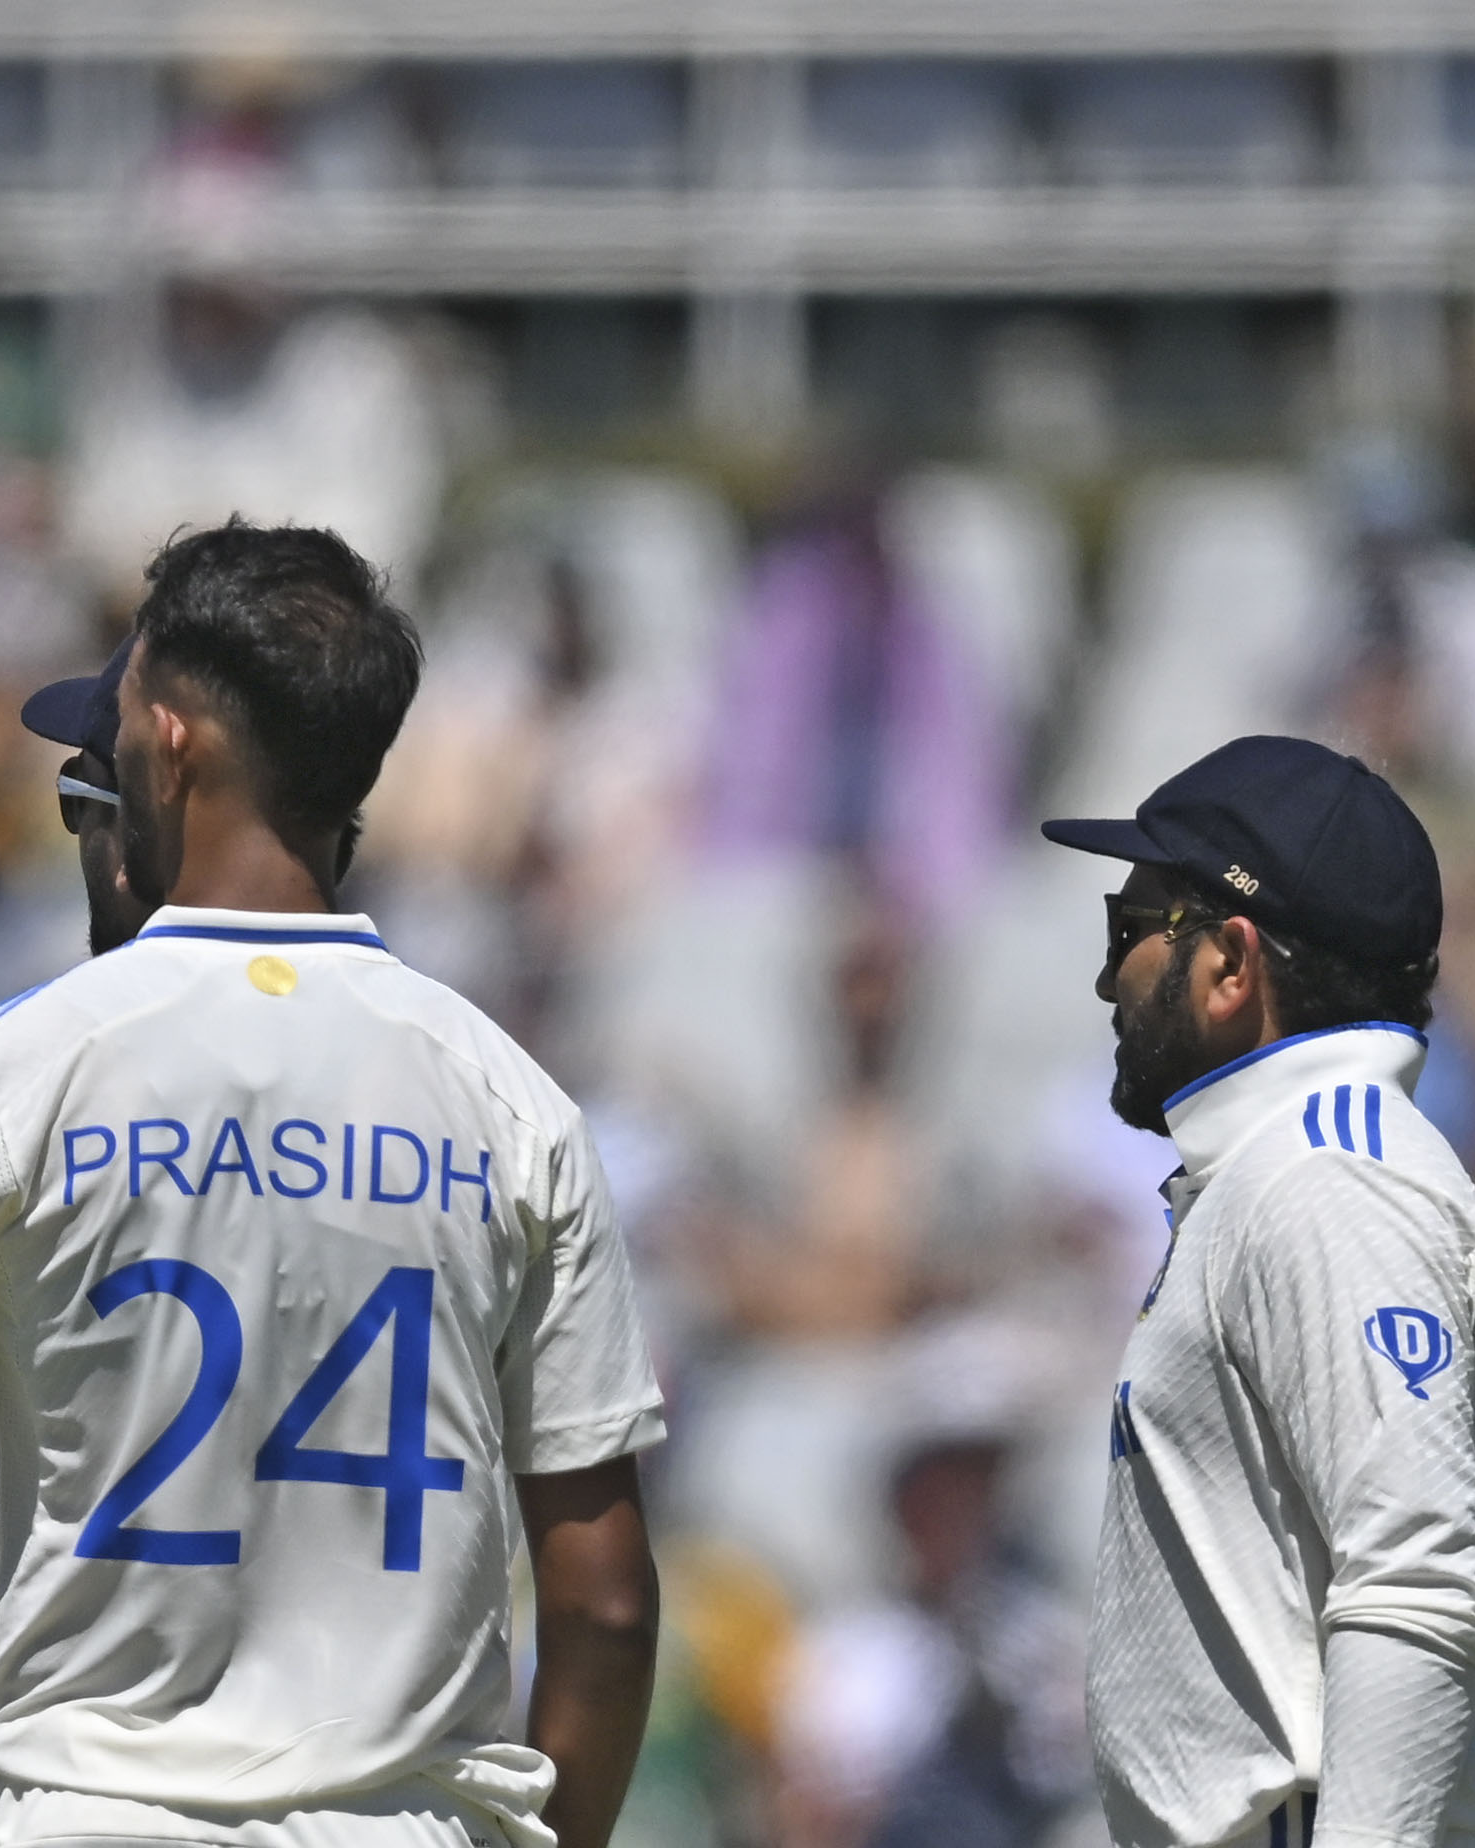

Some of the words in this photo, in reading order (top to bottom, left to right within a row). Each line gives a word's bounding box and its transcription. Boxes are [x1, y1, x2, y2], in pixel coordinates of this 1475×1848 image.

[1223, 864, 1259, 896] 280
[62, 1117, 492, 1223] PRASIDH
[74, 1257, 464, 1573] 24
